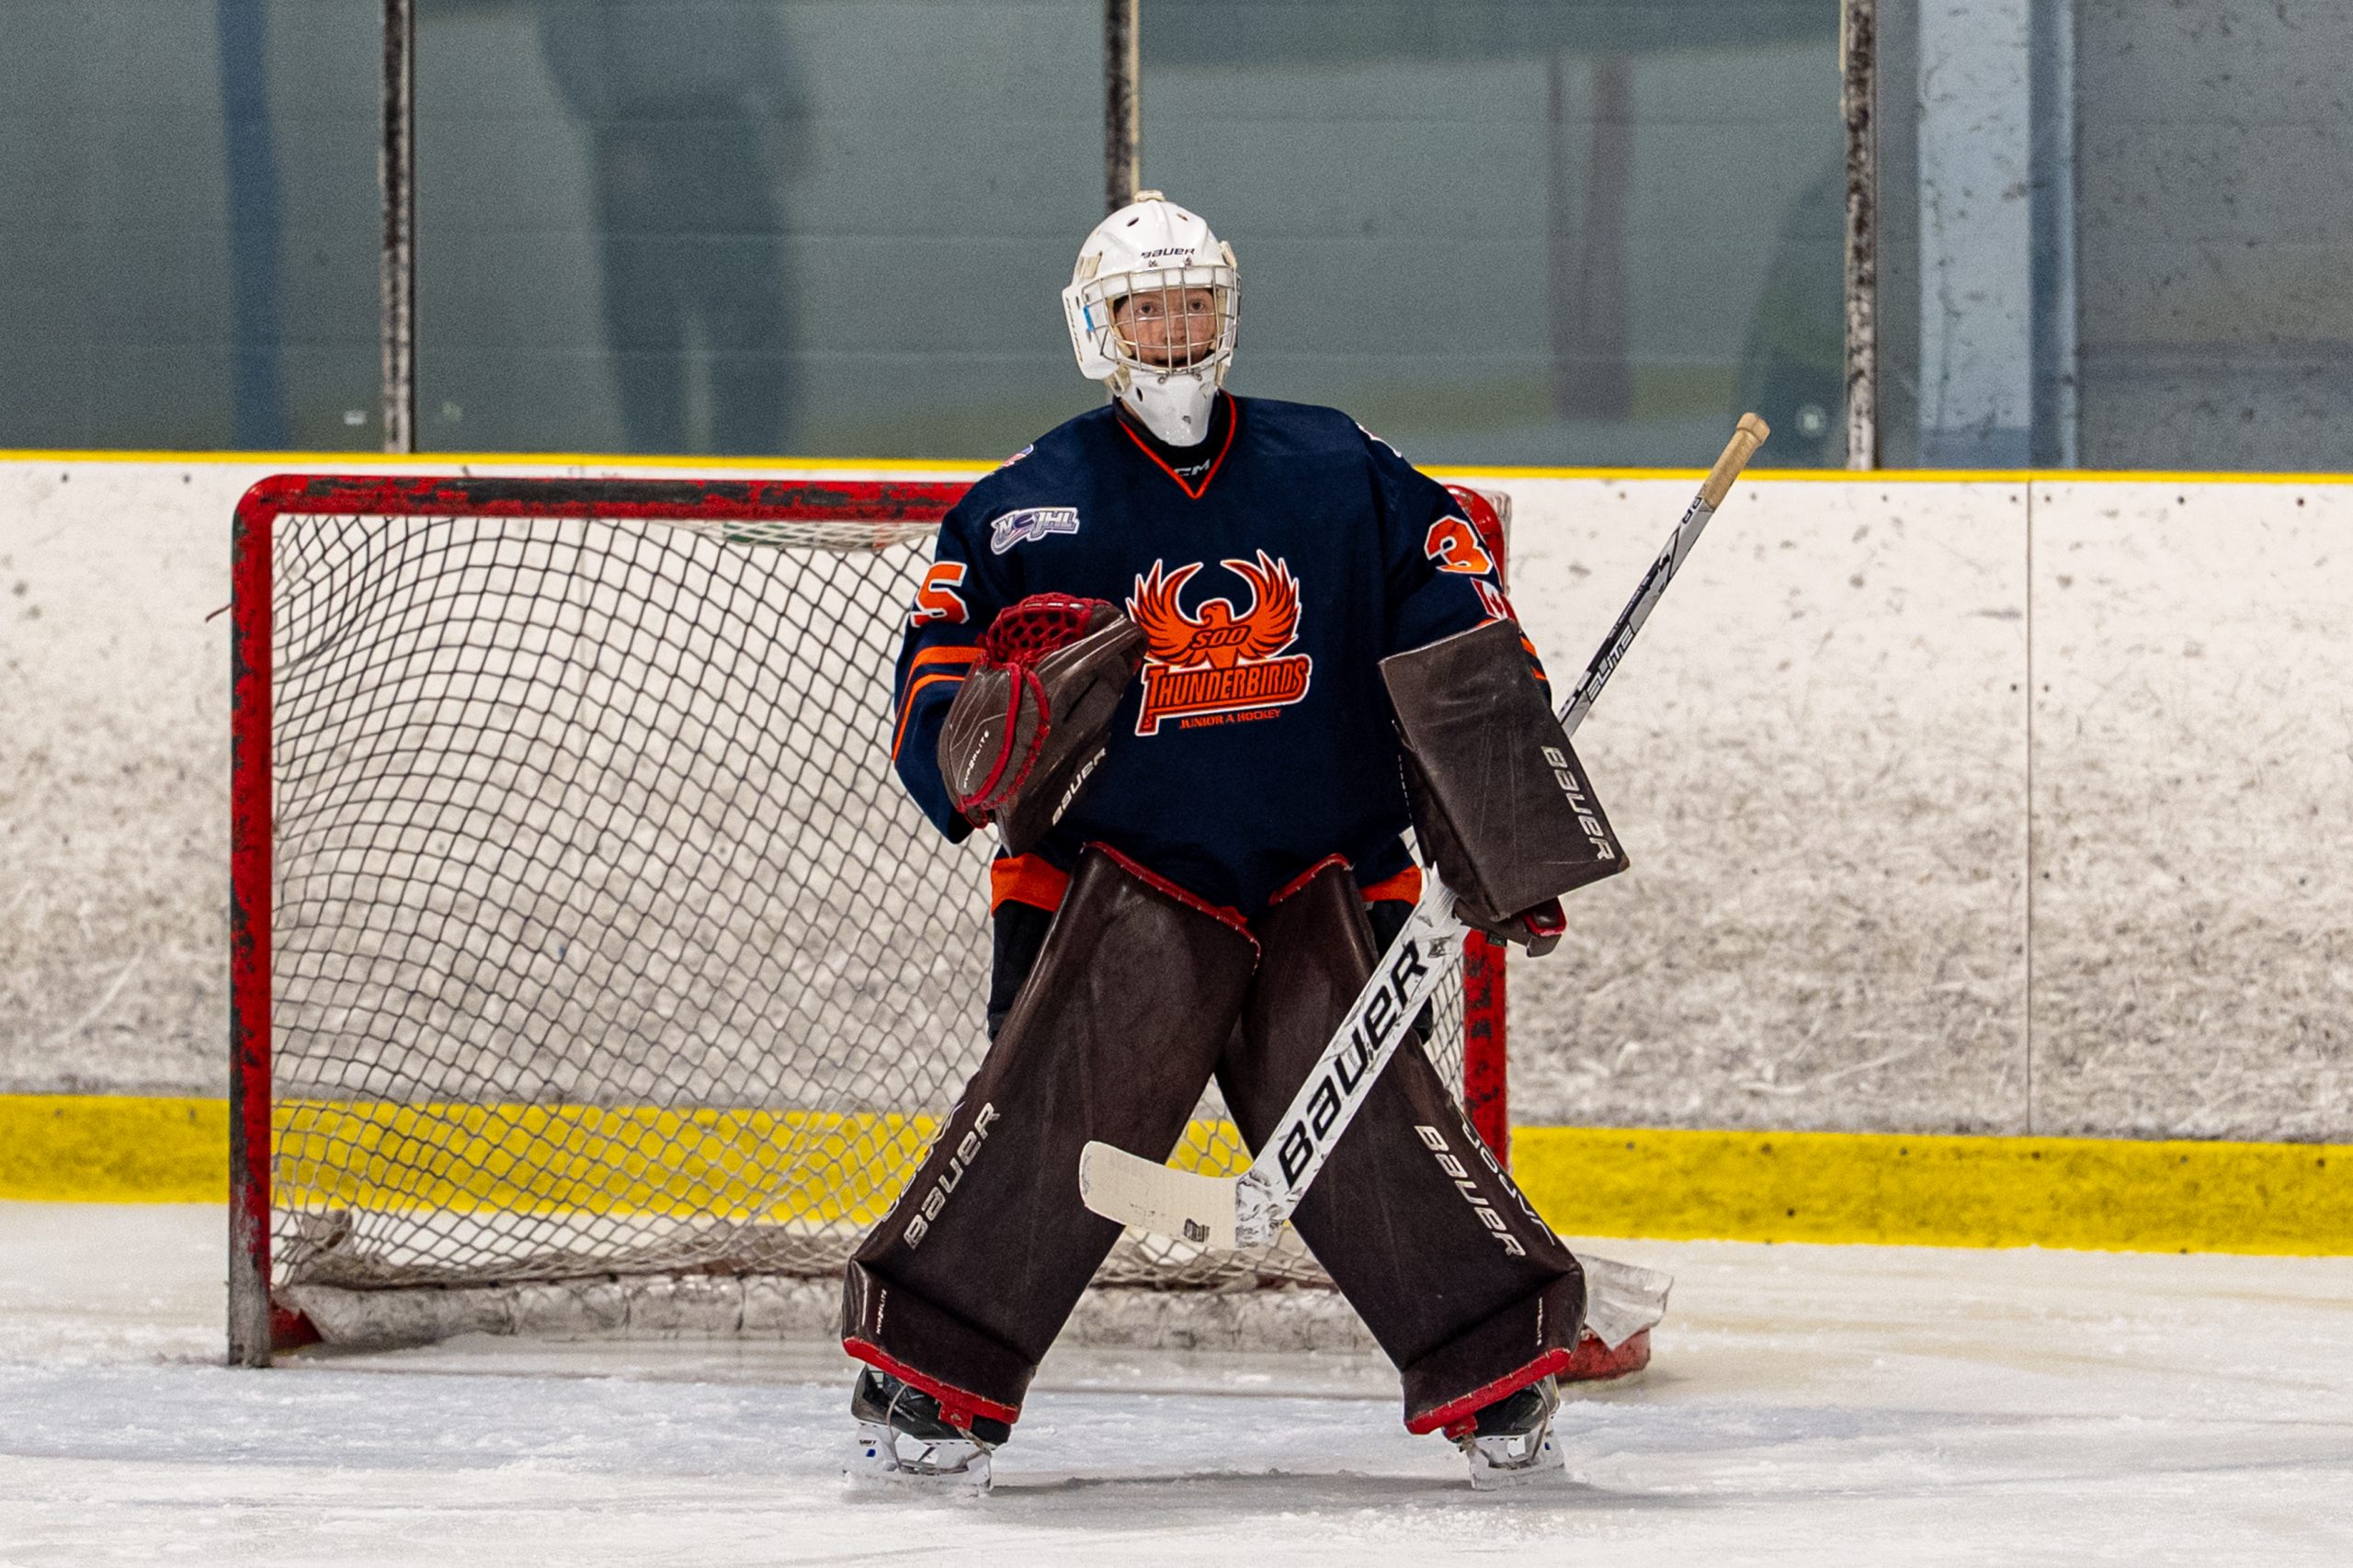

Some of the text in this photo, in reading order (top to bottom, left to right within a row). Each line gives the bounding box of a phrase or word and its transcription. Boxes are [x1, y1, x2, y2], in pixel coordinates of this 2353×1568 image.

[1141, 247, 1195, 258] BAUER
[1192, 627, 1250, 649] SOO
[1586, 622, 1635, 702] ELITE
[1145, 656, 1308, 710] THUNDERBIRDS
[1179, 709, 1281, 730] JUNIOR A HOCKEY
[1051, 747, 1107, 826] BAUER
[1541, 745, 1616, 861] BAUER
[1279, 937, 1429, 1189] BAUER
[903, 1102, 1001, 1251] BAUER
[1414, 1125, 1527, 1256] BAUER
